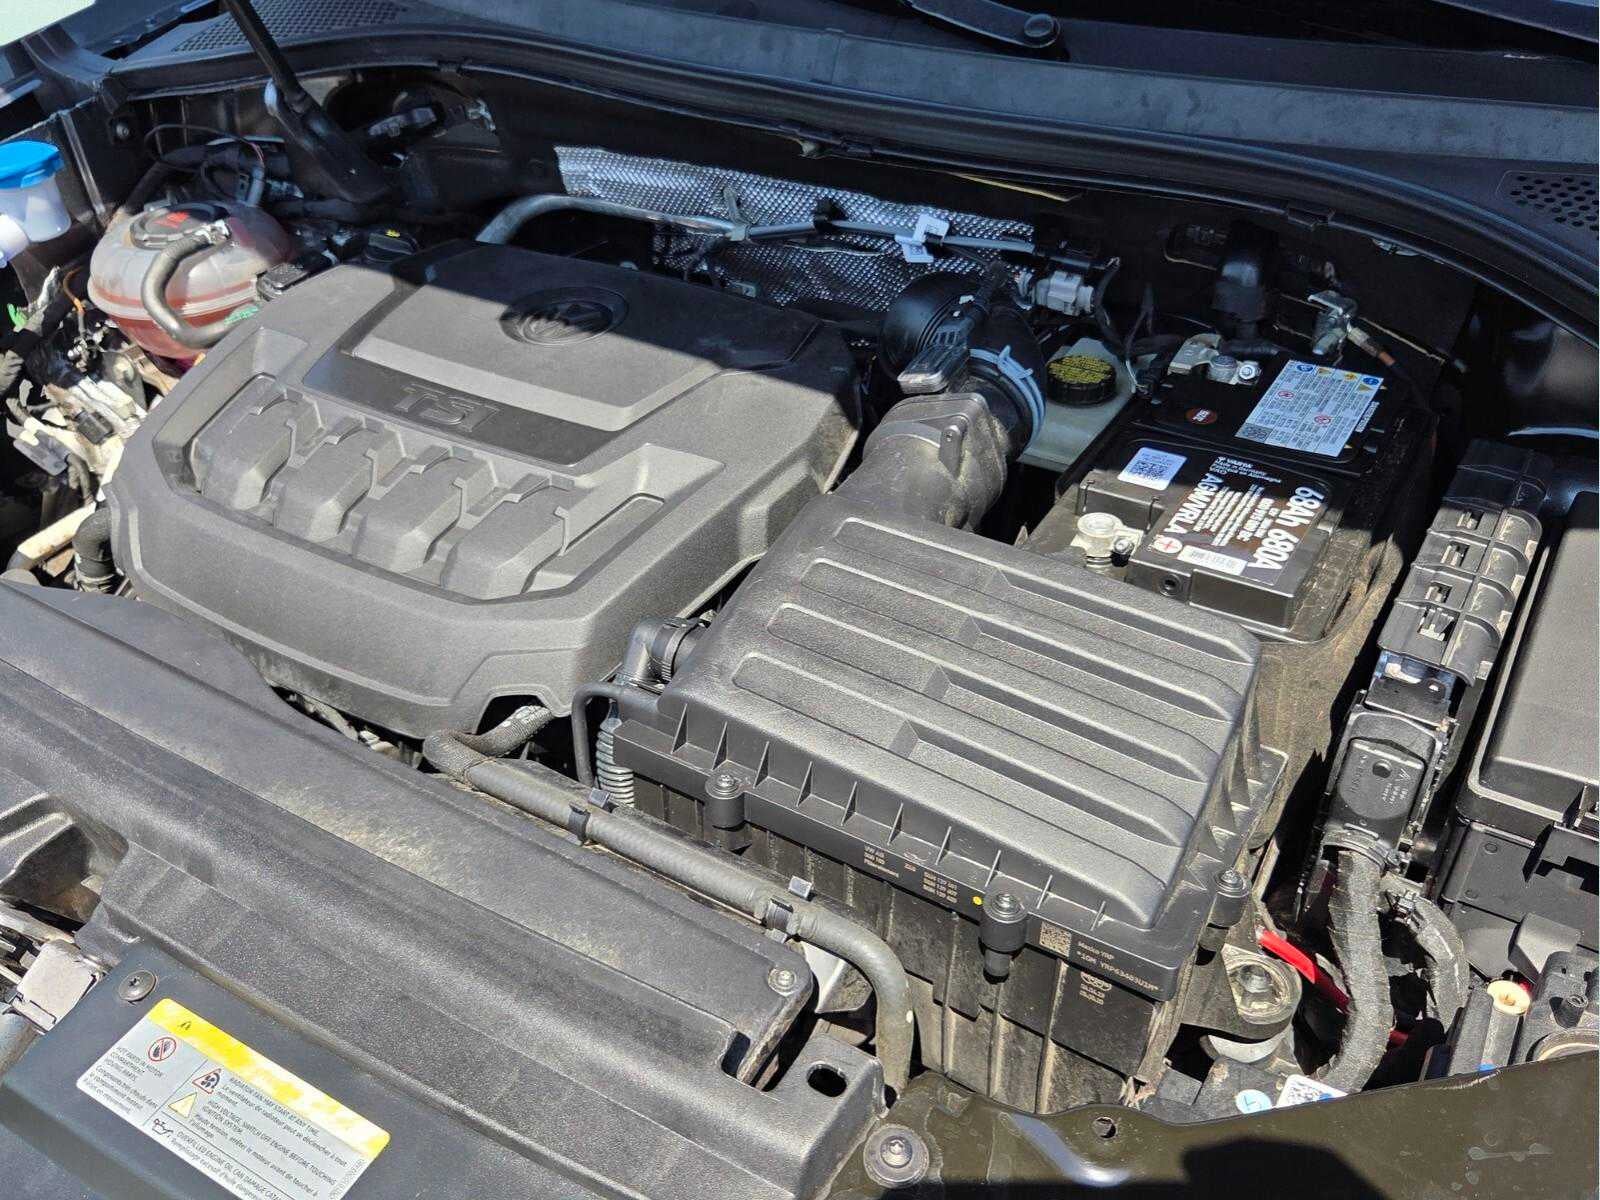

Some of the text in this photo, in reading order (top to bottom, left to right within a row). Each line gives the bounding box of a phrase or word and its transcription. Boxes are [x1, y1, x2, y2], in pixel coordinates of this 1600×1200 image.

[394, 384, 500, 432] TSI
[1276, 486, 1325, 526] 68Ah
[1247, 528, 1301, 569] 680A
[229, 1075, 253, 1094] RADIATOR
[273, 1103, 289, 1117] START
[228, 1087, 255, 1107] ventilateur
[283, 1123, 295, 1135] peut
[302, 1134, 331, 1157] déclencher
[333, 1155, 347, 1167] tout
[176, 1130, 207, 1154] OVERFILLED
[204, 1149, 225, 1166] ENGINE
[232, 1167, 245, 1179] CAN
[243, 1175, 266, 1194] DAMAGE
[250, 1150, 269, 1165] moteur
[292, 1177, 313, 1194] toucher
[269, 1139, 289, 1155] ENGINE
[288, 1151, 309, 1168] BEFORE
[307, 1163, 337, 1186] TOUCHING
